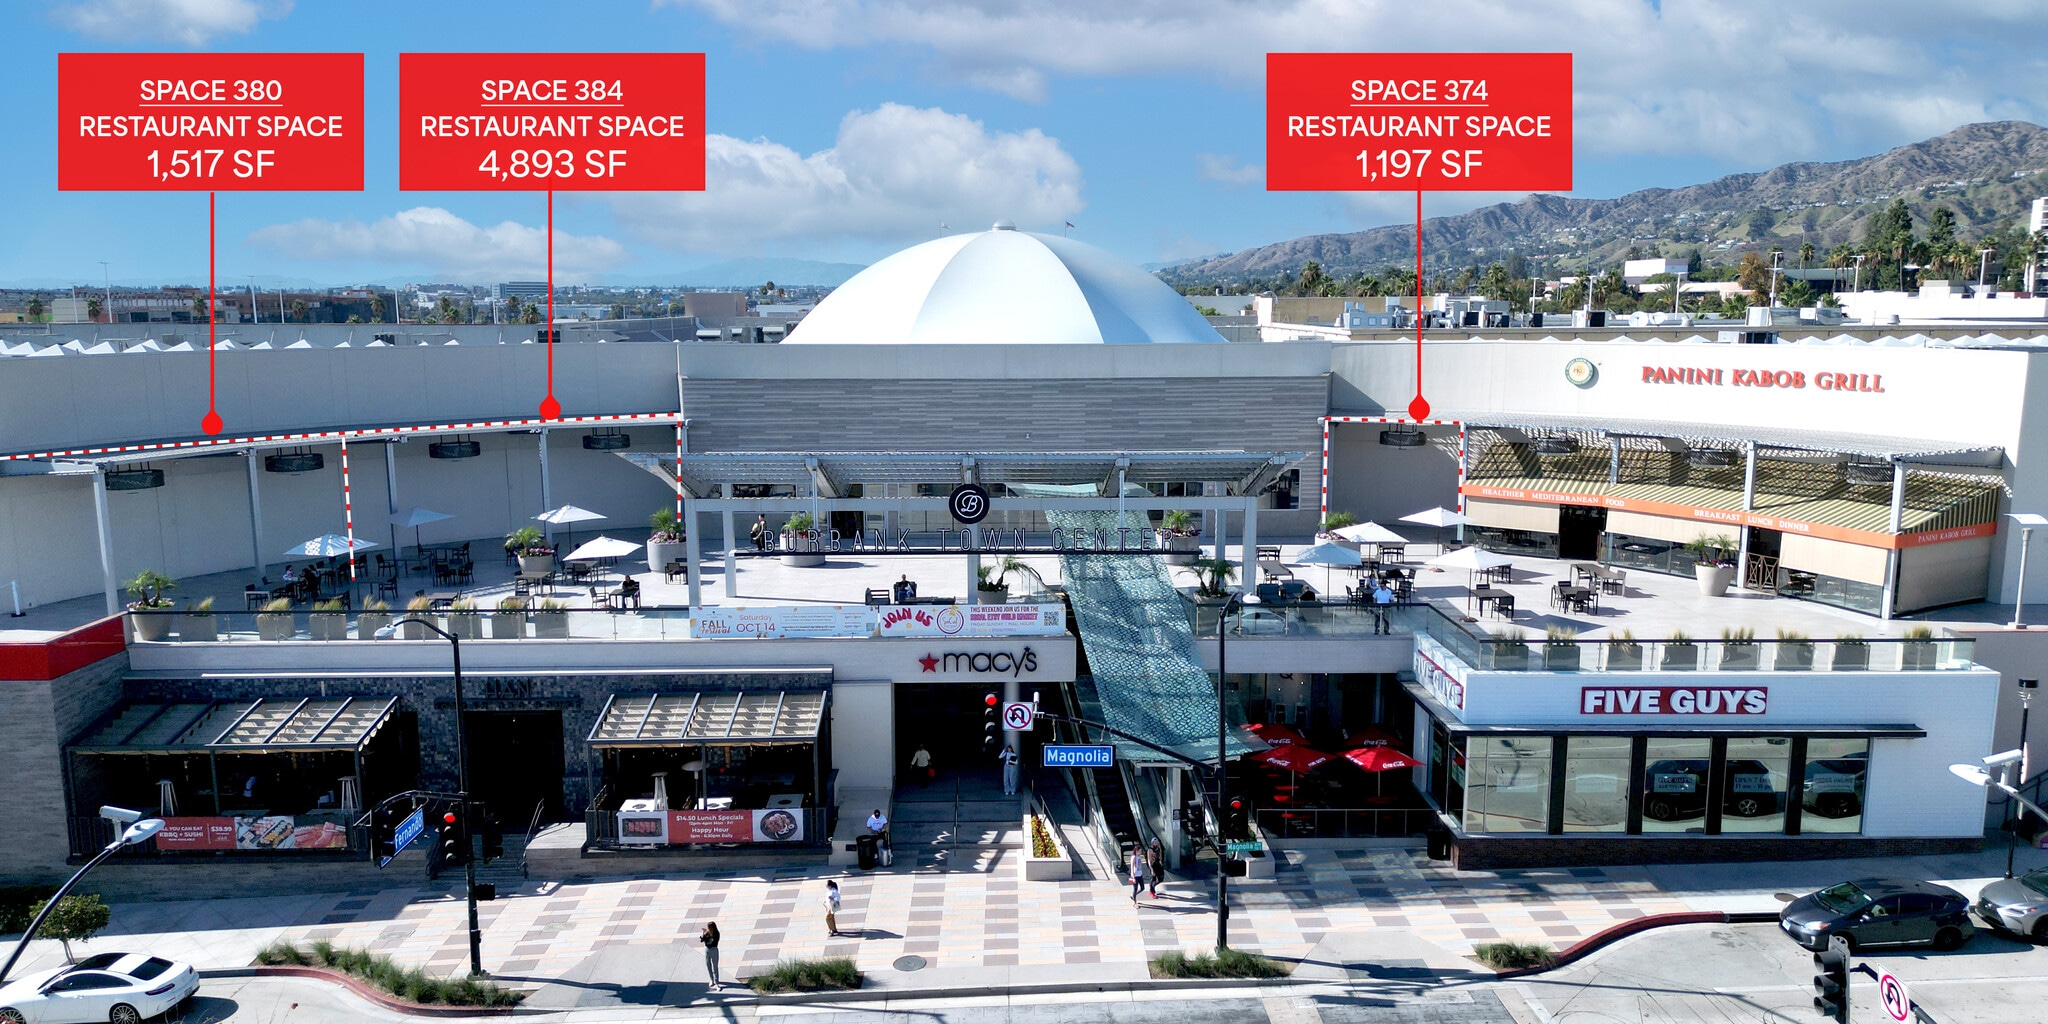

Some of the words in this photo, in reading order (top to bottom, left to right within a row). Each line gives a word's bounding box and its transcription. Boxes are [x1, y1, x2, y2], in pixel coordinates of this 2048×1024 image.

[1641, 365, 1723, 386] PANINI
[1731, 368, 1806, 389] KABOB
[1813, 370, 1886, 393] GRILL
[1481, 487, 1525, 499] HEALTHIER
[1531, 492, 1599, 504] MEDITERRANEAN
[1605, 498, 1625, 507] FOOD
[1693, 508, 1741, 522] BREAKFAST
[1747, 516, 1773, 527] LUNCH
[1779, 519, 1810, 532] DINNER
[763, 528, 912, 552] BURBANK
[936, 527, 1027, 552] TOWN
[1051, 527, 1176, 552] CENTER
[1917, 532, 1938, 543] PANINI
[1939, 530, 1960, 540] KABOB
[1960, 527, 1977, 537] GRILL
[701, 619, 726, 629] FALL
[736, 622, 760, 633] OCT
[763, 622, 776, 633] 14
[739, 614, 773, 622] Saturday
[882, 607, 912, 629] JOIN
[915, 609, 934, 627] US
[943, 646, 1038, 678] macy's
[1413, 652, 1436, 684] FIVE
[1432, 668, 1462, 706] GUYS
[1583, 688, 1661, 714] FIVE
[1669, 689, 1768, 714] GUYS
[1047, 749, 1110, 766] Magnolia
[394, 813, 424, 850] Fernando
[1227, 842, 1254, 852] Magnolia
